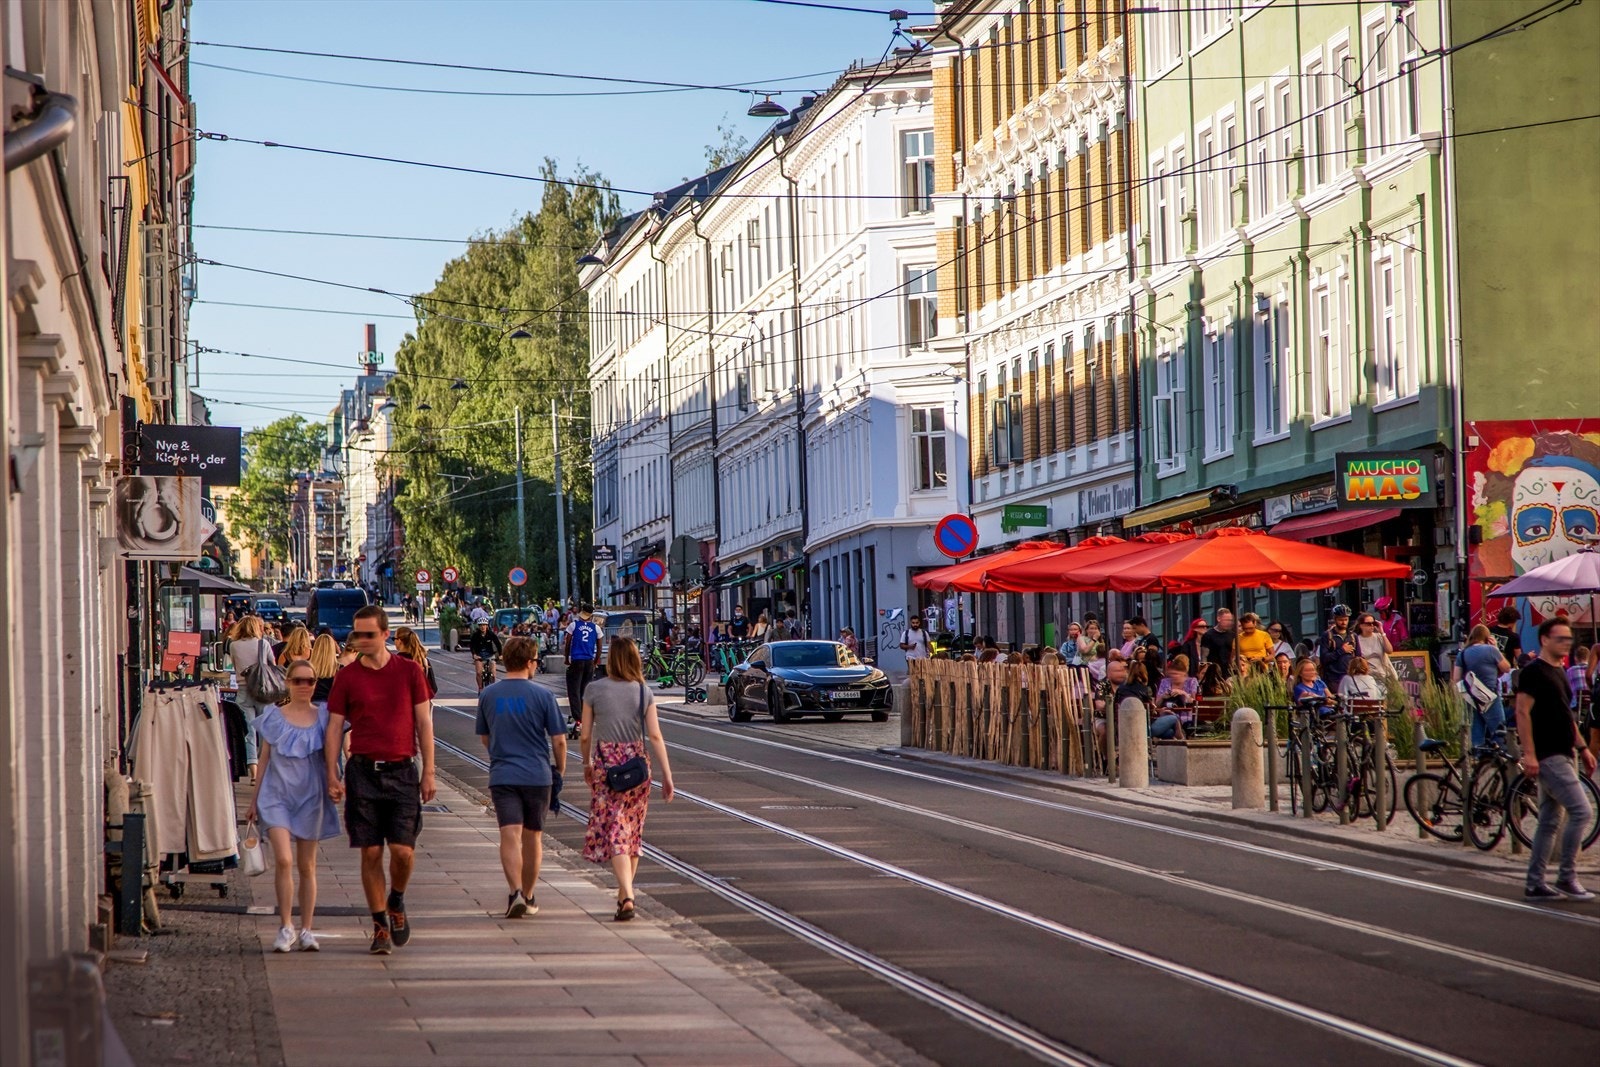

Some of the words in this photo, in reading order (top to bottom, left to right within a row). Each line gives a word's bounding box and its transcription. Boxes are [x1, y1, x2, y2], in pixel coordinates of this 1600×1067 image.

[156, 440, 179, 452] Nye
[180, 440, 190, 451] &
[1349, 460, 1420, 476] MUCHO
[1347, 476, 1420, 501] MAS
[582, 630, 589, 642] 2
